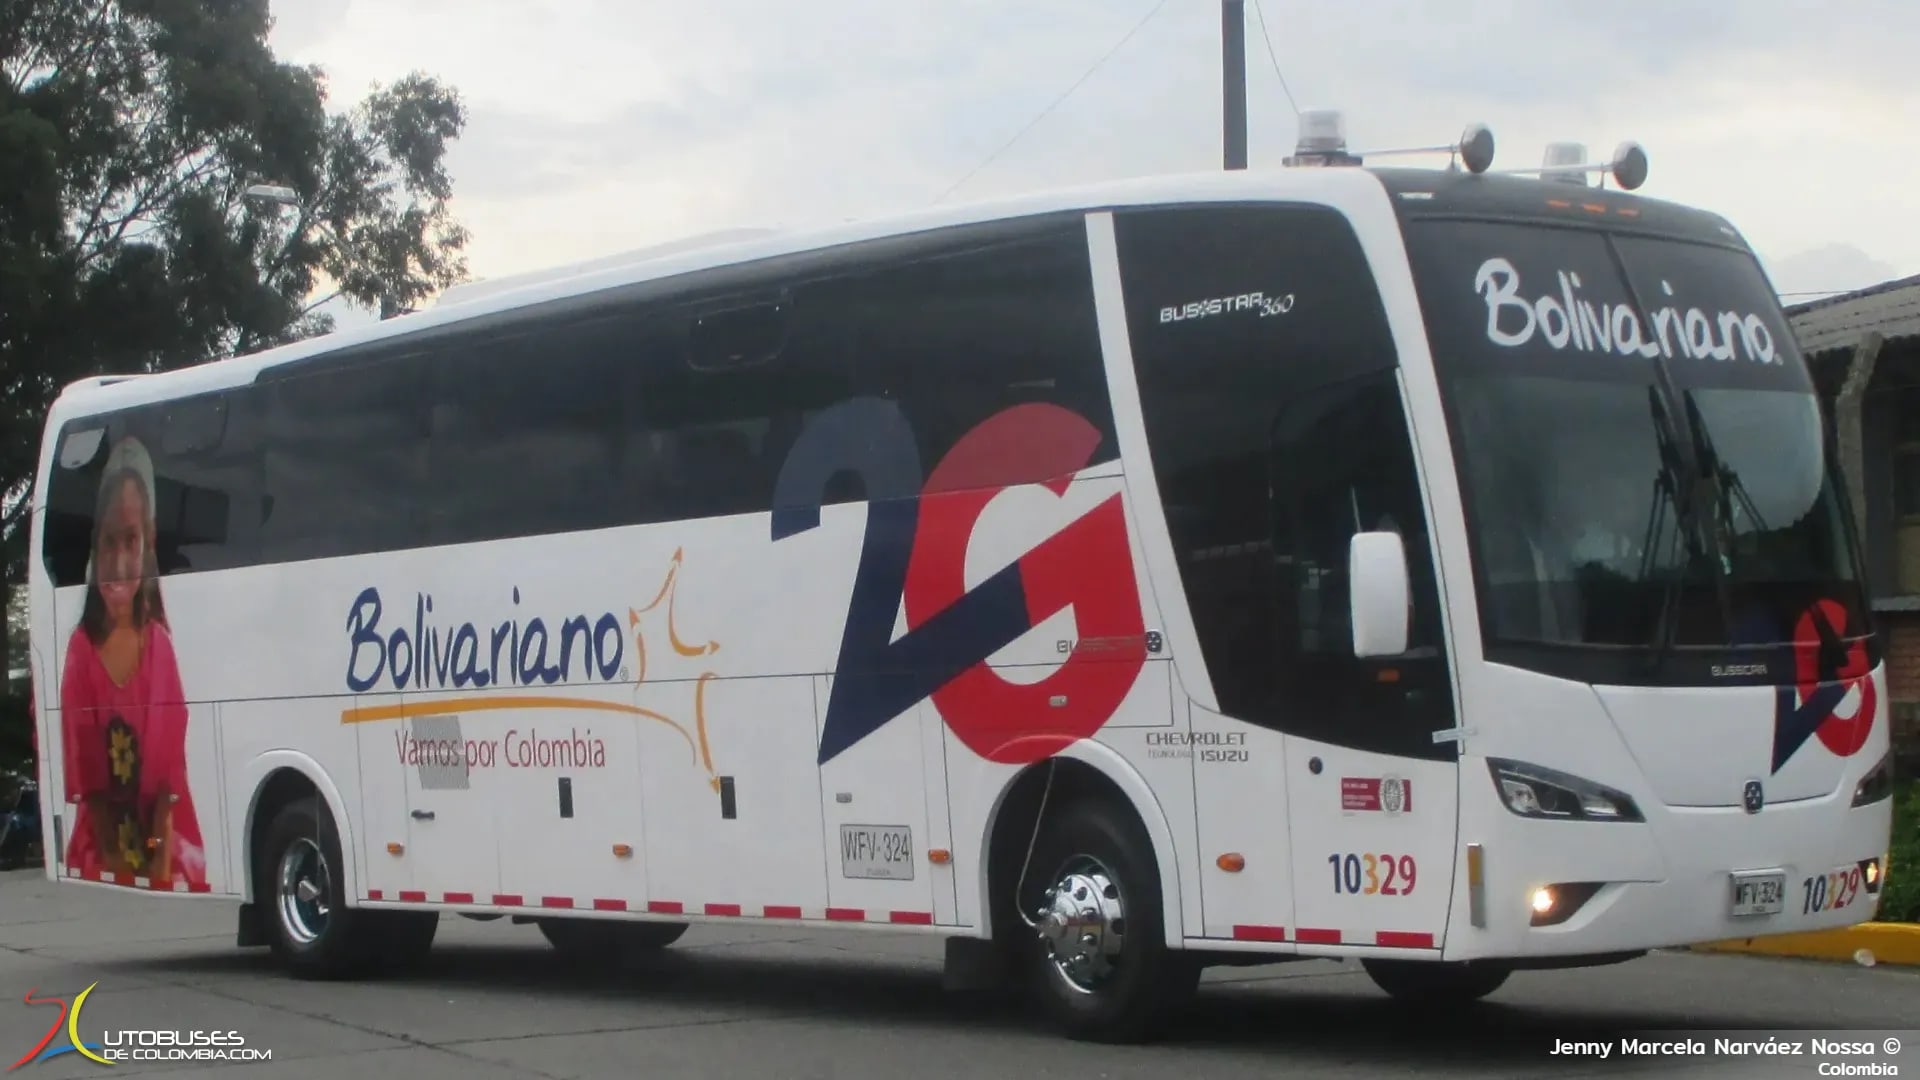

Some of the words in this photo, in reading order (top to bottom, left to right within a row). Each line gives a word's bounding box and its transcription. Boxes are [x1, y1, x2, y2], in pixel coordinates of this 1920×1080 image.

[1475, 257, 1775, 364] Bolivariano
[346, 586, 624, 693] Bolivariano
[395, 729, 460, 766] Vamos
[464, 738, 498, 776] por
[504, 728, 606, 768] Colombia
[1146, 732, 1248, 746] CHEVROLET
[1201, 750, 1249, 762] ISUZU
[843, 831, 911, 862] WFV-324
[1328, 853, 1417, 896] 10329
[1803, 867, 1860, 916] 10329
